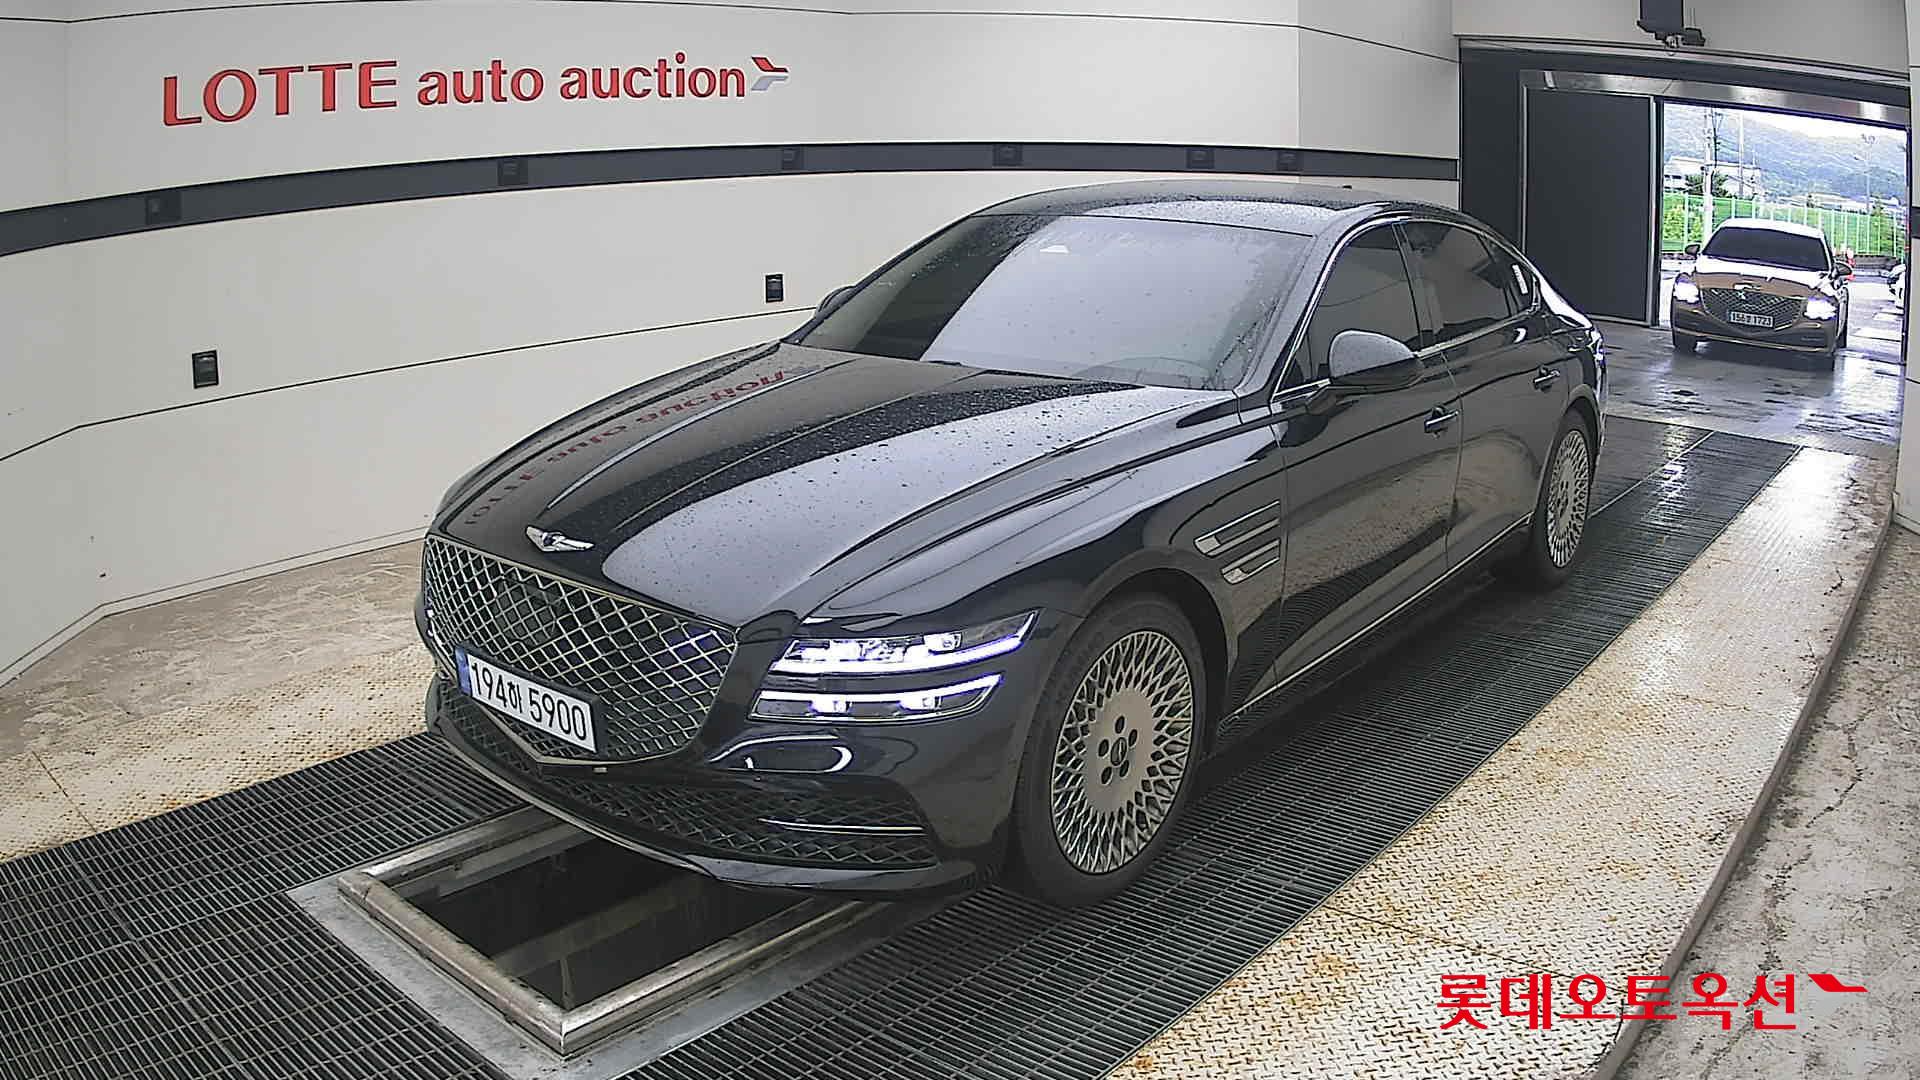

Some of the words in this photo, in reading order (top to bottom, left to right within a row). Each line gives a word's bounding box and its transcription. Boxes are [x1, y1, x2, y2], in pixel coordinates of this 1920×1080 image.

[162, 59, 399, 127] LOTTE
[416, 59, 545, 106] auto
[559, 51, 746, 100] auction
[471, 662, 523, 714] 194하
[528, 687, 587, 741] 5900
